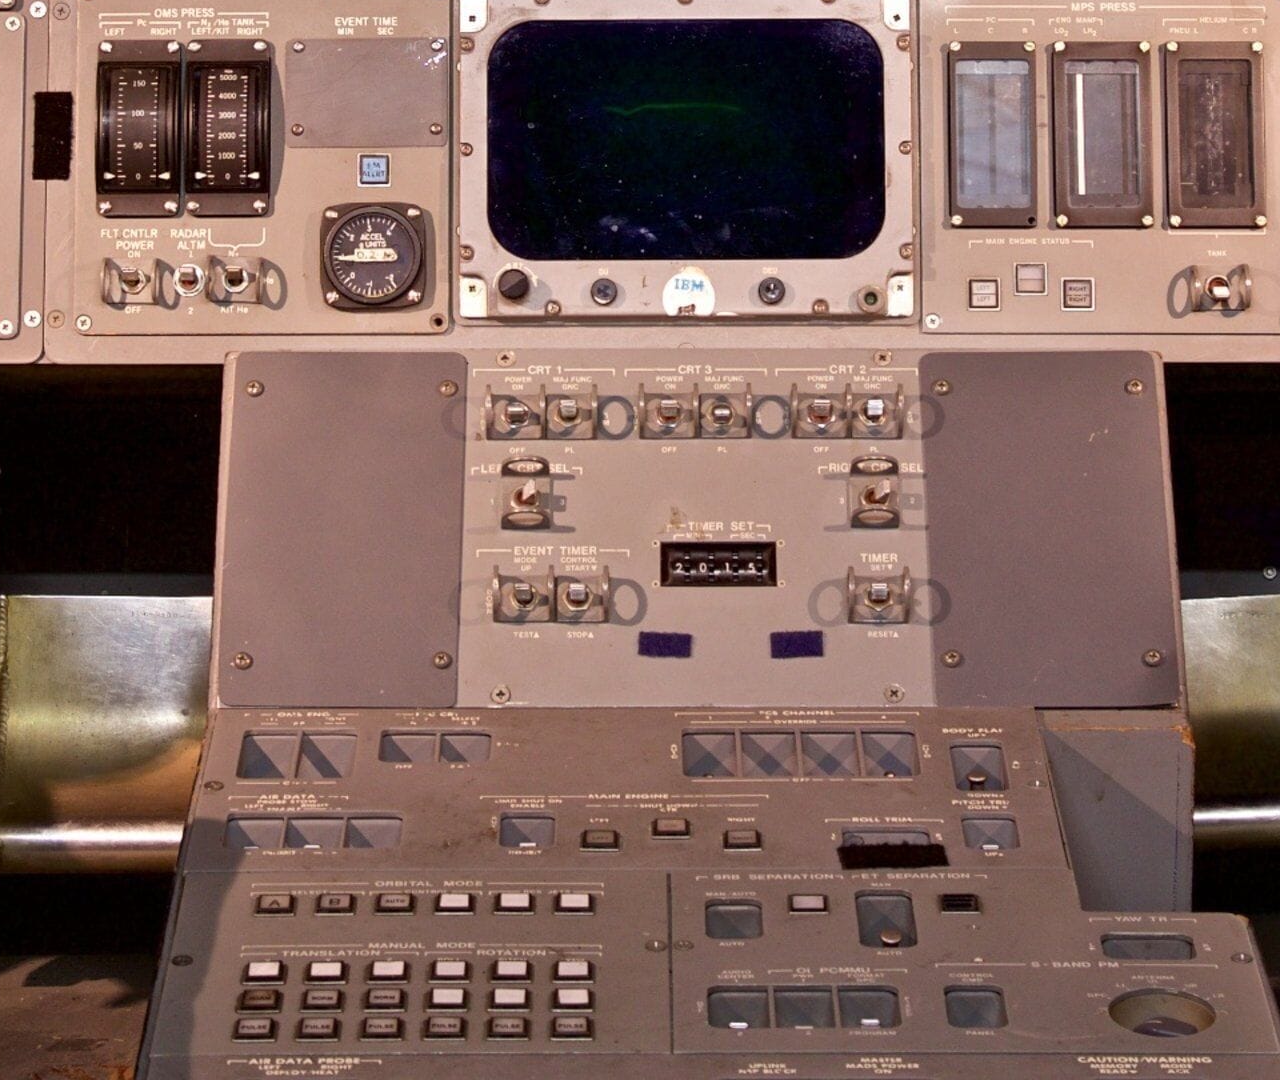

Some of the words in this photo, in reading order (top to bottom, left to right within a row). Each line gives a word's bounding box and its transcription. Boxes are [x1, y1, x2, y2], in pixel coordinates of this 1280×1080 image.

[1071, 2, 1095, 12] MPS
[1100, 2, 1136, 12] PRESS
[154, 8, 179, 18] OMS
[181, 7, 215, 18] PRESS
[334, 17, 367, 27] EVENT
[372, 17, 398, 27] TIME
[1199, 16, 1228, 24] HELIUM
[104, 28, 125, 36] LEFT
[150, 28, 177, 36] RIGHT
[191, 27, 230, 36] LEFT/KIT
[236, 28, 263, 36] RIGHT
[376, 28, 394, 36] SEC
[101, 229, 119, 238] FLT
[122, 229, 158, 238] CNTLR
[170, 229, 207, 238] RADAR
[360, 233, 384, 241] ACCEL
[116, 240, 154, 250] POWER
[177, 240, 206, 250] ALTM
[365, 240, 387, 248] UNITS
[674, 277, 705, 291] IBM
[527, 365, 552, 375] CRT
[556, 365, 562, 375] 1
[678, 365, 703, 375] CRT
[705, 365, 712, 375] 3
[829, 365, 854, 374] CRT
[859, 365, 866, 374] 2
[512, 383, 524, 391] ON
[549, 464, 570, 473] SEL
[900, 463, 924, 472] SEL
[689, 522, 724, 531] TIMER
[730, 522, 755, 531] SET
[513, 546, 554, 555] EVENT
[560, 546, 597, 555] TIMER
[860, 553, 898, 562] TIMER
[675, 562, 683, 572] 2
[699, 562, 707, 572] 0
[725, 562, 731, 572] 1
[748, 562, 756, 572] 5
